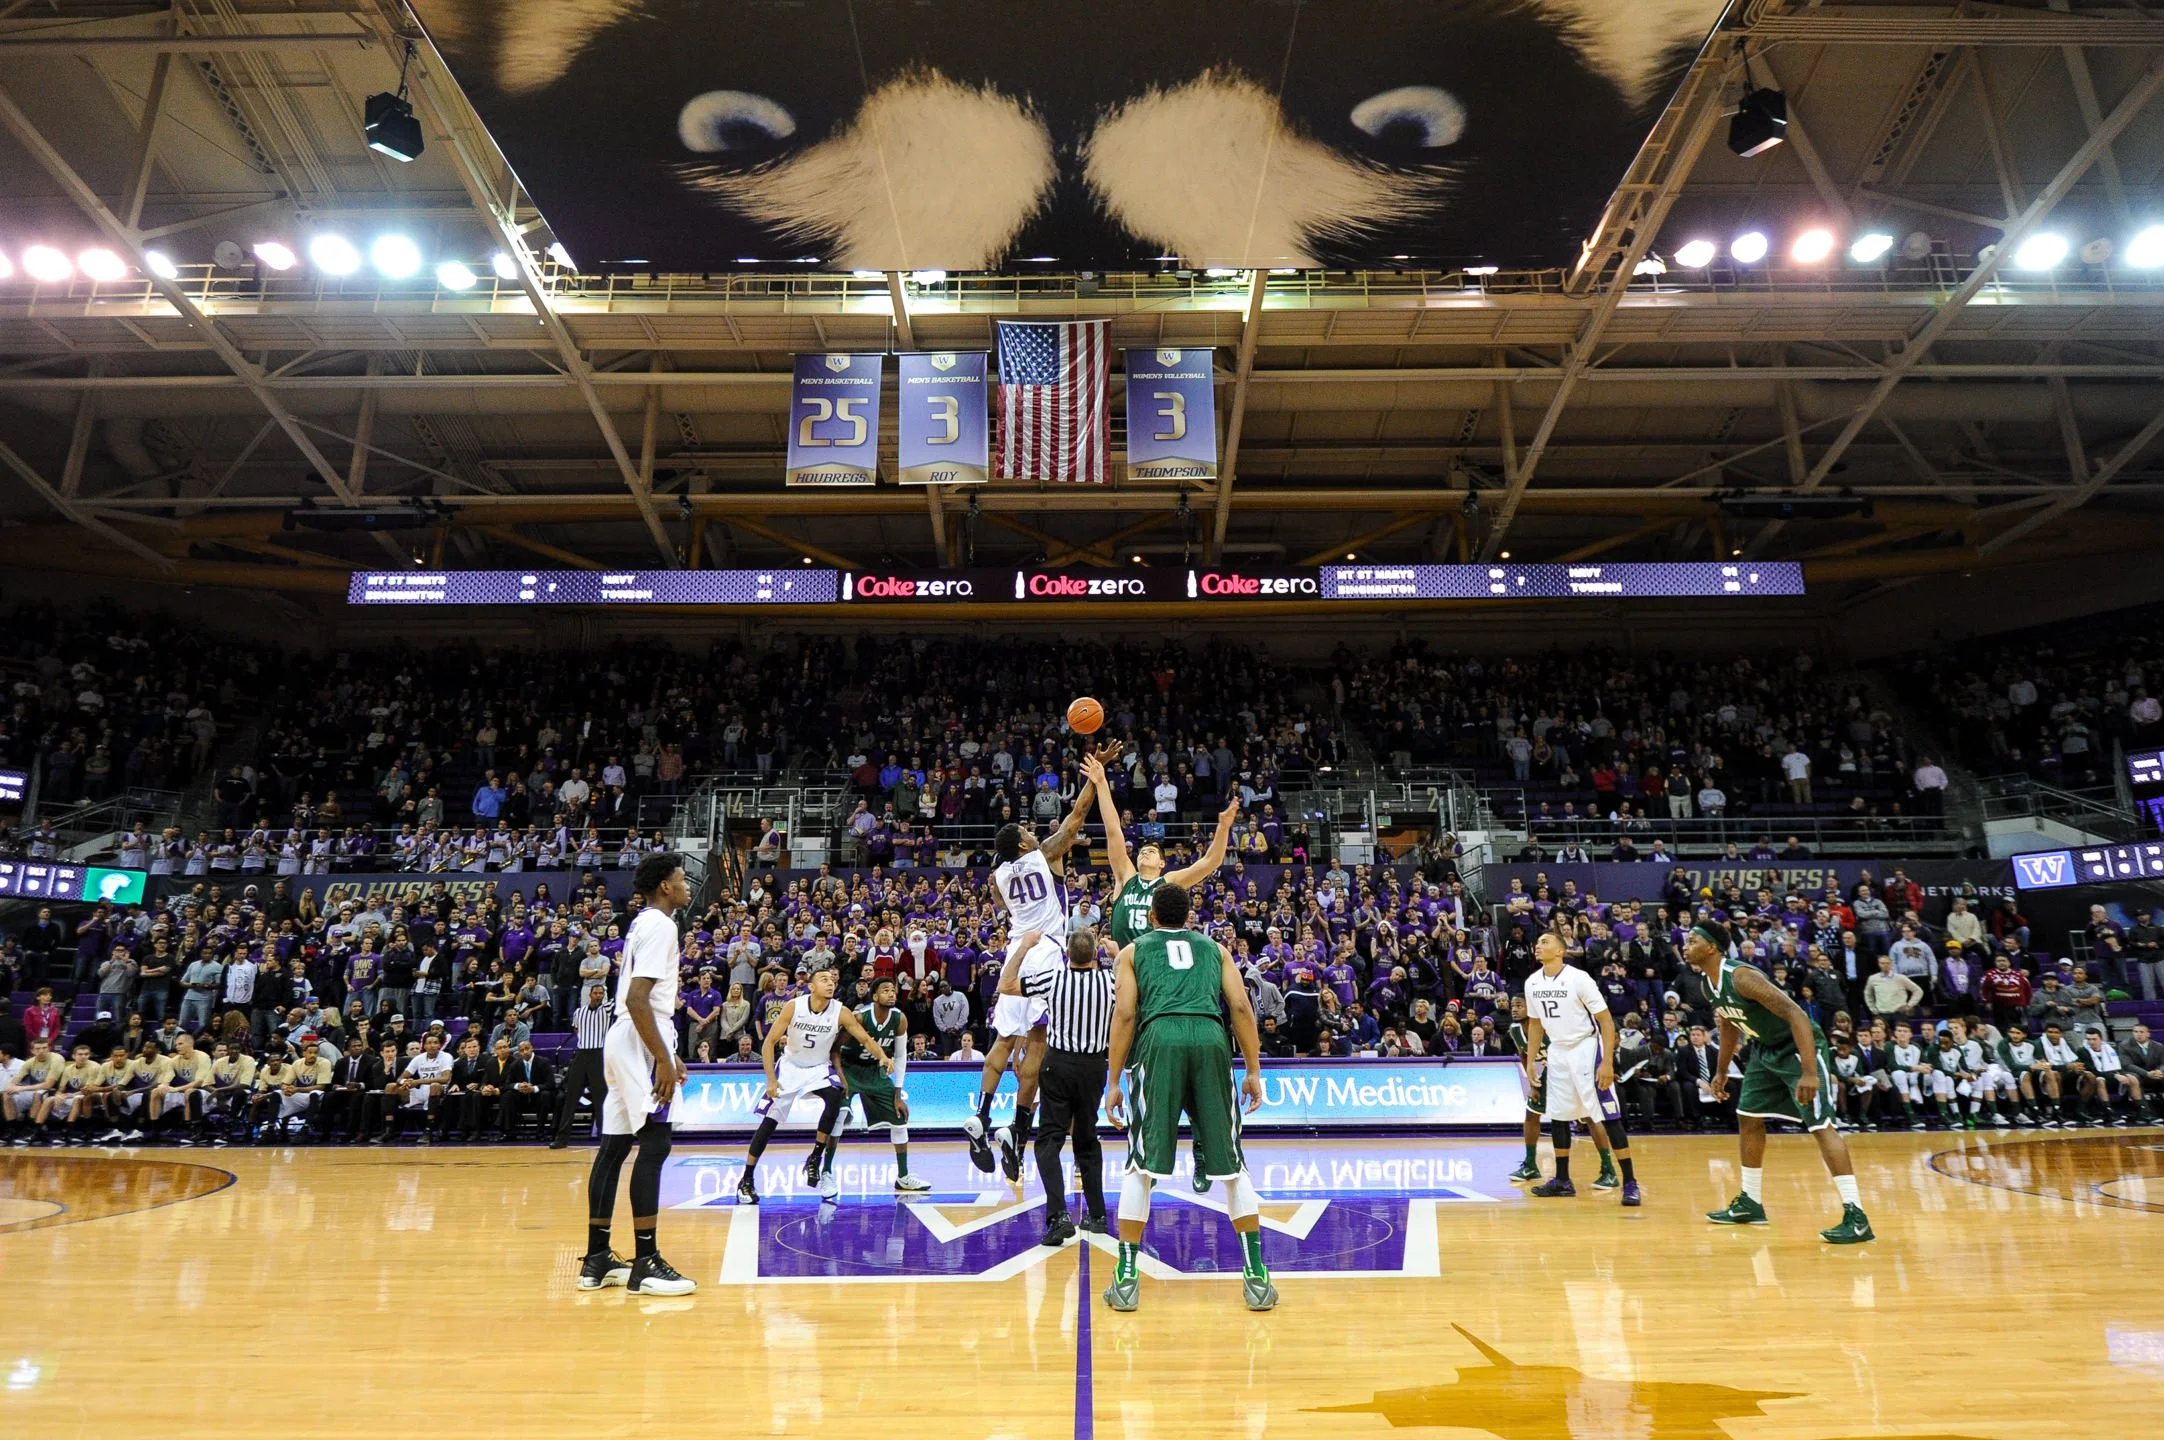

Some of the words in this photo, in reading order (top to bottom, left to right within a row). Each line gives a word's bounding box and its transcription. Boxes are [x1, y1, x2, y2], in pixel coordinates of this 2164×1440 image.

[831, 356, 845, 371] W
[936, 355, 950, 367] W
[1163, 352, 1175, 362] W
[824, 376, 874, 385] BASKETBALL
[907, 376, 929, 385] MEN'S
[931, 375, 980, 384] BASKETBALL
[798, 397, 869, 447] 25
[926, 396, 959, 445] 3
[1153, 392, 1186, 441] 3
[795, 472, 867, 483] HOUBREGS
[930, 471, 958, 482] ROY
[1136, 467, 1208, 478] THOMPSON
[857, 576, 915, 597] Coke
[1029, 575, 1087, 595] Coke
[1201, 574, 1259, 594] Coke
[2018, 855, 2066, 885] W
[1009, 872, 1047, 904] 40
[1123, 893, 1153, 906] TULAN
[1129, 909, 1147, 930] 15
[1166, 940, 1194, 970] 0
[1533, 990, 1568, 999] HUSKIES
[942, 1000, 956, 1012] W
[1542, 1000, 1560, 1018] 12
[794, 1022, 832, 1033] HUSKIES
[803, 1034, 816, 1048] 5
[700, 1082, 766, 1112] UW
[1262, 1077, 1319, 1106] UW
[1327, 1076, 1468, 1107] Medicine
